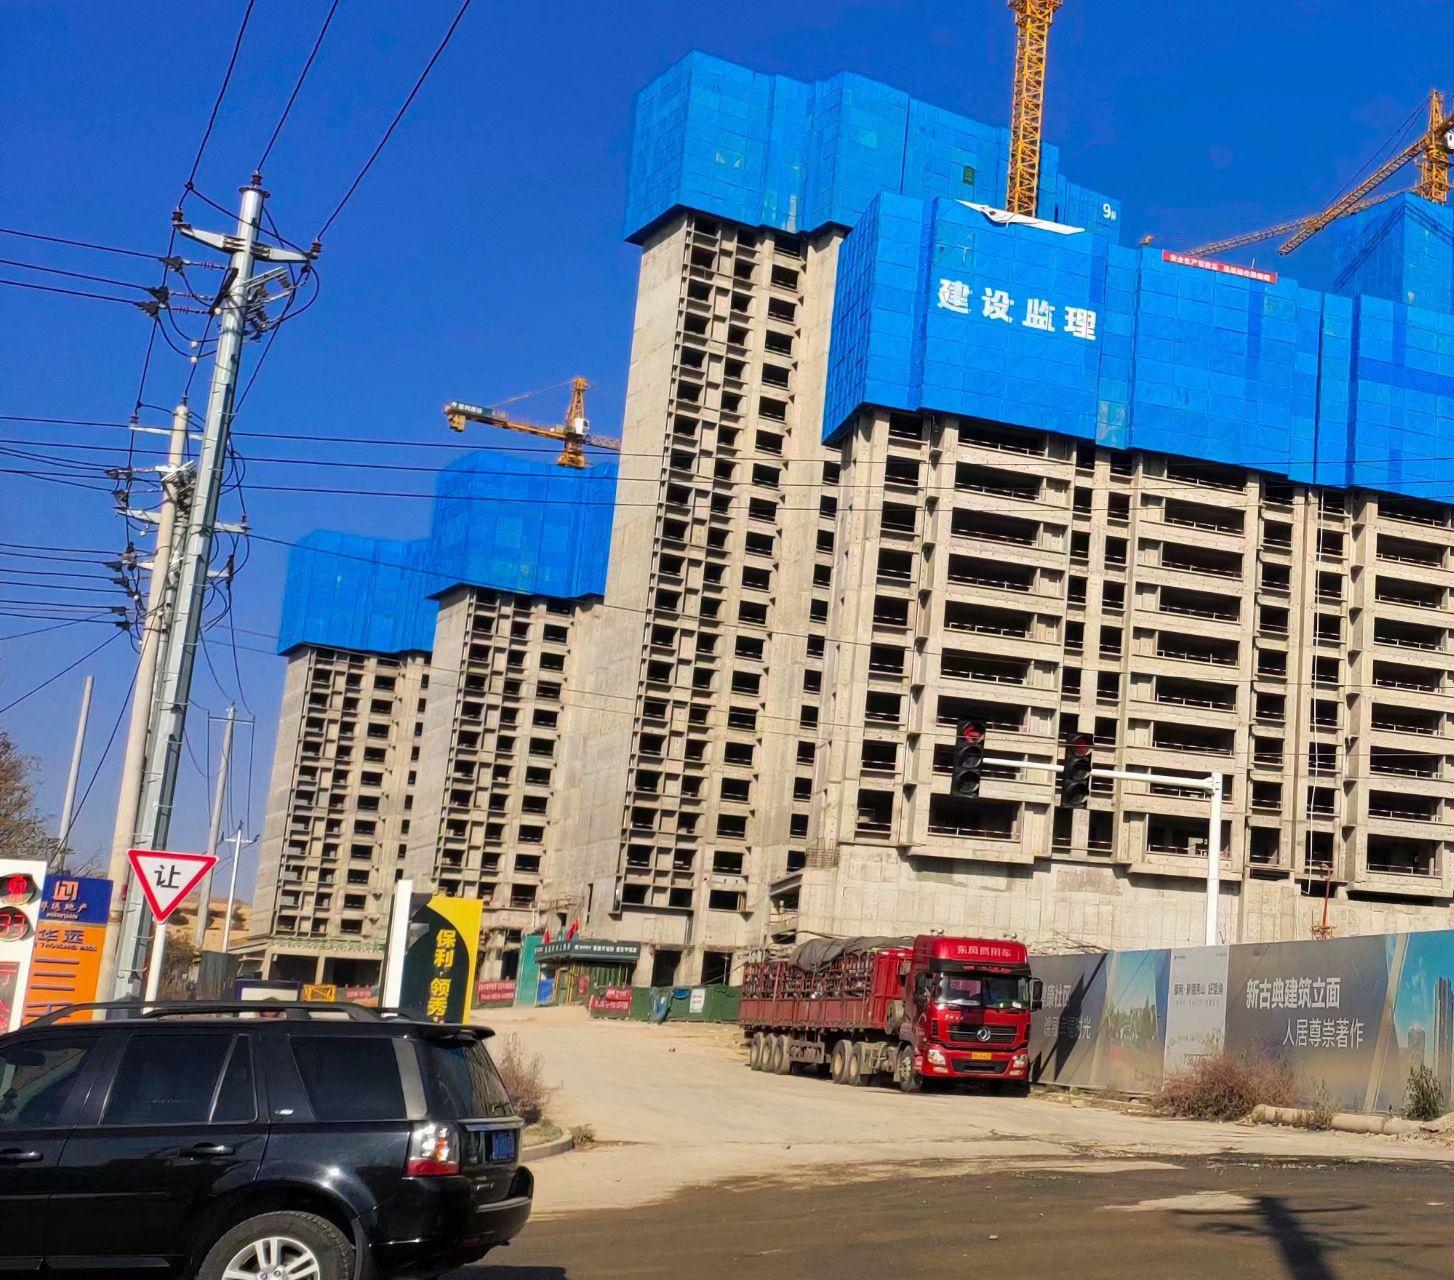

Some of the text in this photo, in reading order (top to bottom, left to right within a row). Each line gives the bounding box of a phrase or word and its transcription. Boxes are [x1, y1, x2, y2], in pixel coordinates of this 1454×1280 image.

[937, 278, 1097, 341] 建设监理
[154, 864, 182, 889] 让
[427, 929, 457, 1022] 保利·领秀
[1246, 976, 1341, 1010] 新古典建筑立面
[1283, 1017, 1364, 1049] 人居尊崇著作
